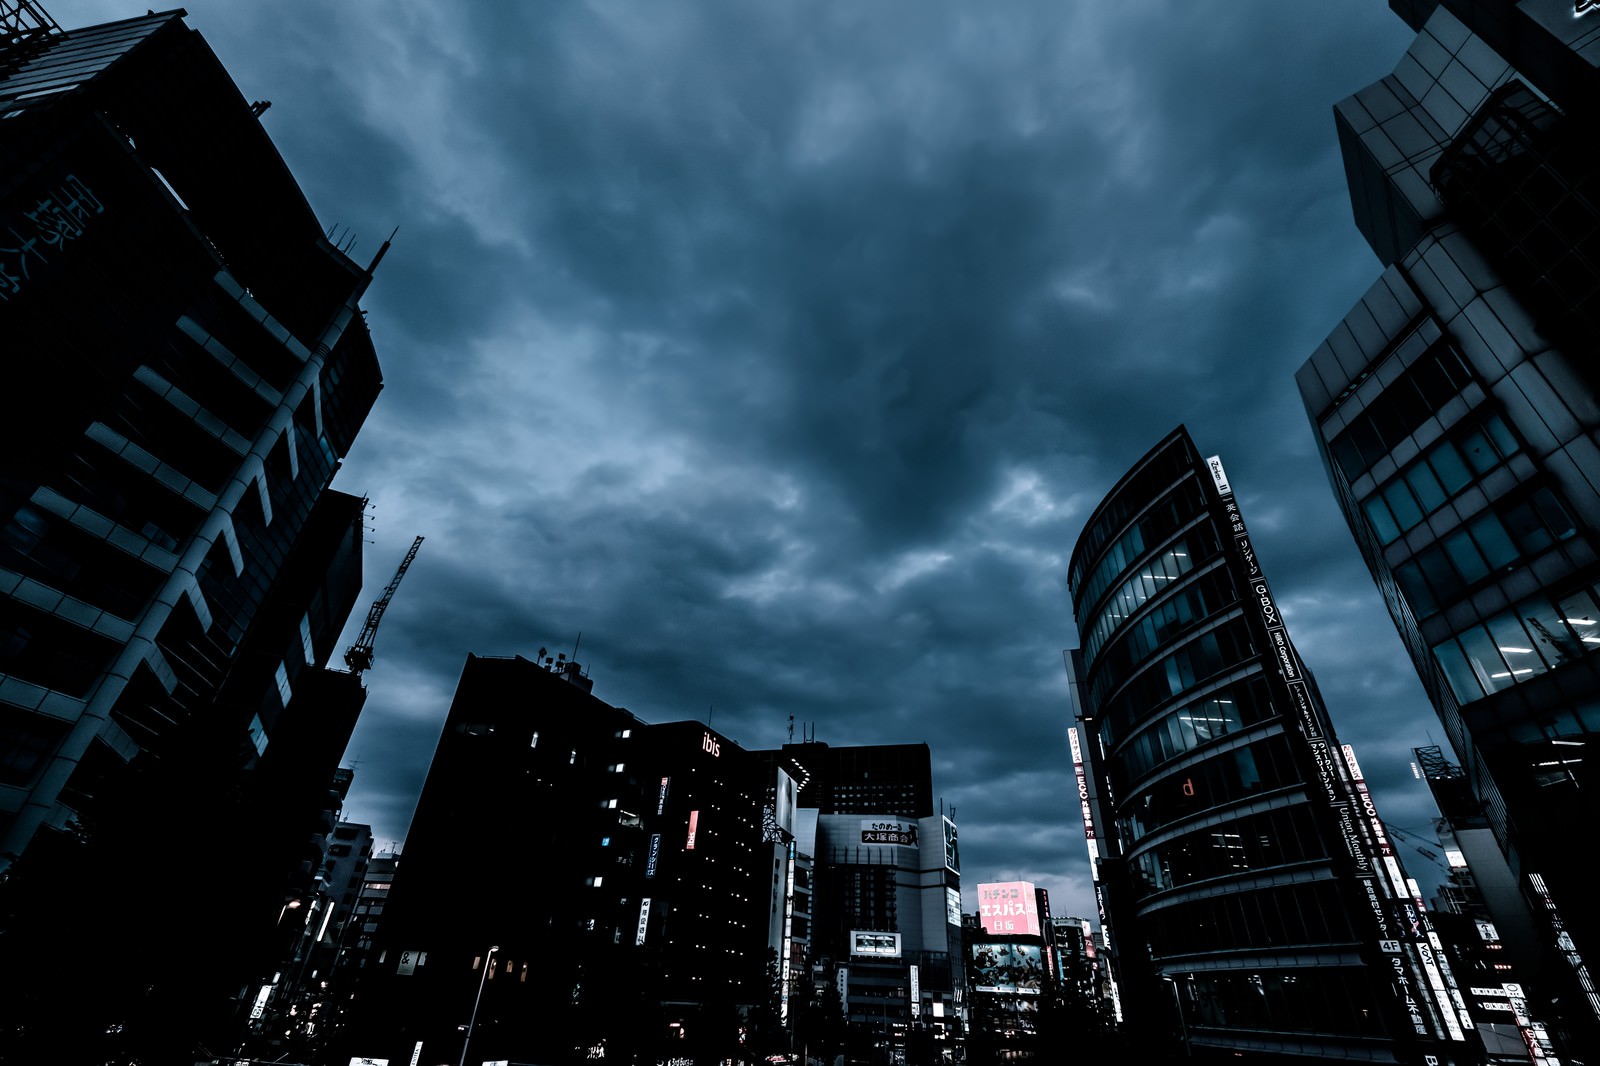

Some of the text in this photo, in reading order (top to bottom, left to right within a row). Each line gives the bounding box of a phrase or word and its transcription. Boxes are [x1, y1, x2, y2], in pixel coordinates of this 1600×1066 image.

[1225, 503, 1244, 532] 英会話
[702, 732, 721, 758] ibis
[872, 822, 903, 832] たのめーる
[864, 832, 910, 843] 大塚商会
[1339, 807, 1355, 833] Union
[1348, 833, 1369, 872] Monthly
[1380, 847, 1391, 855] 7F
[983, 888, 1019, 900] パチンコ
[981, 900, 1026, 917] エスパス
[1382, 941, 1399, 951] 4F
[1391, 957, 1428, 1035] タマホーム不動産
